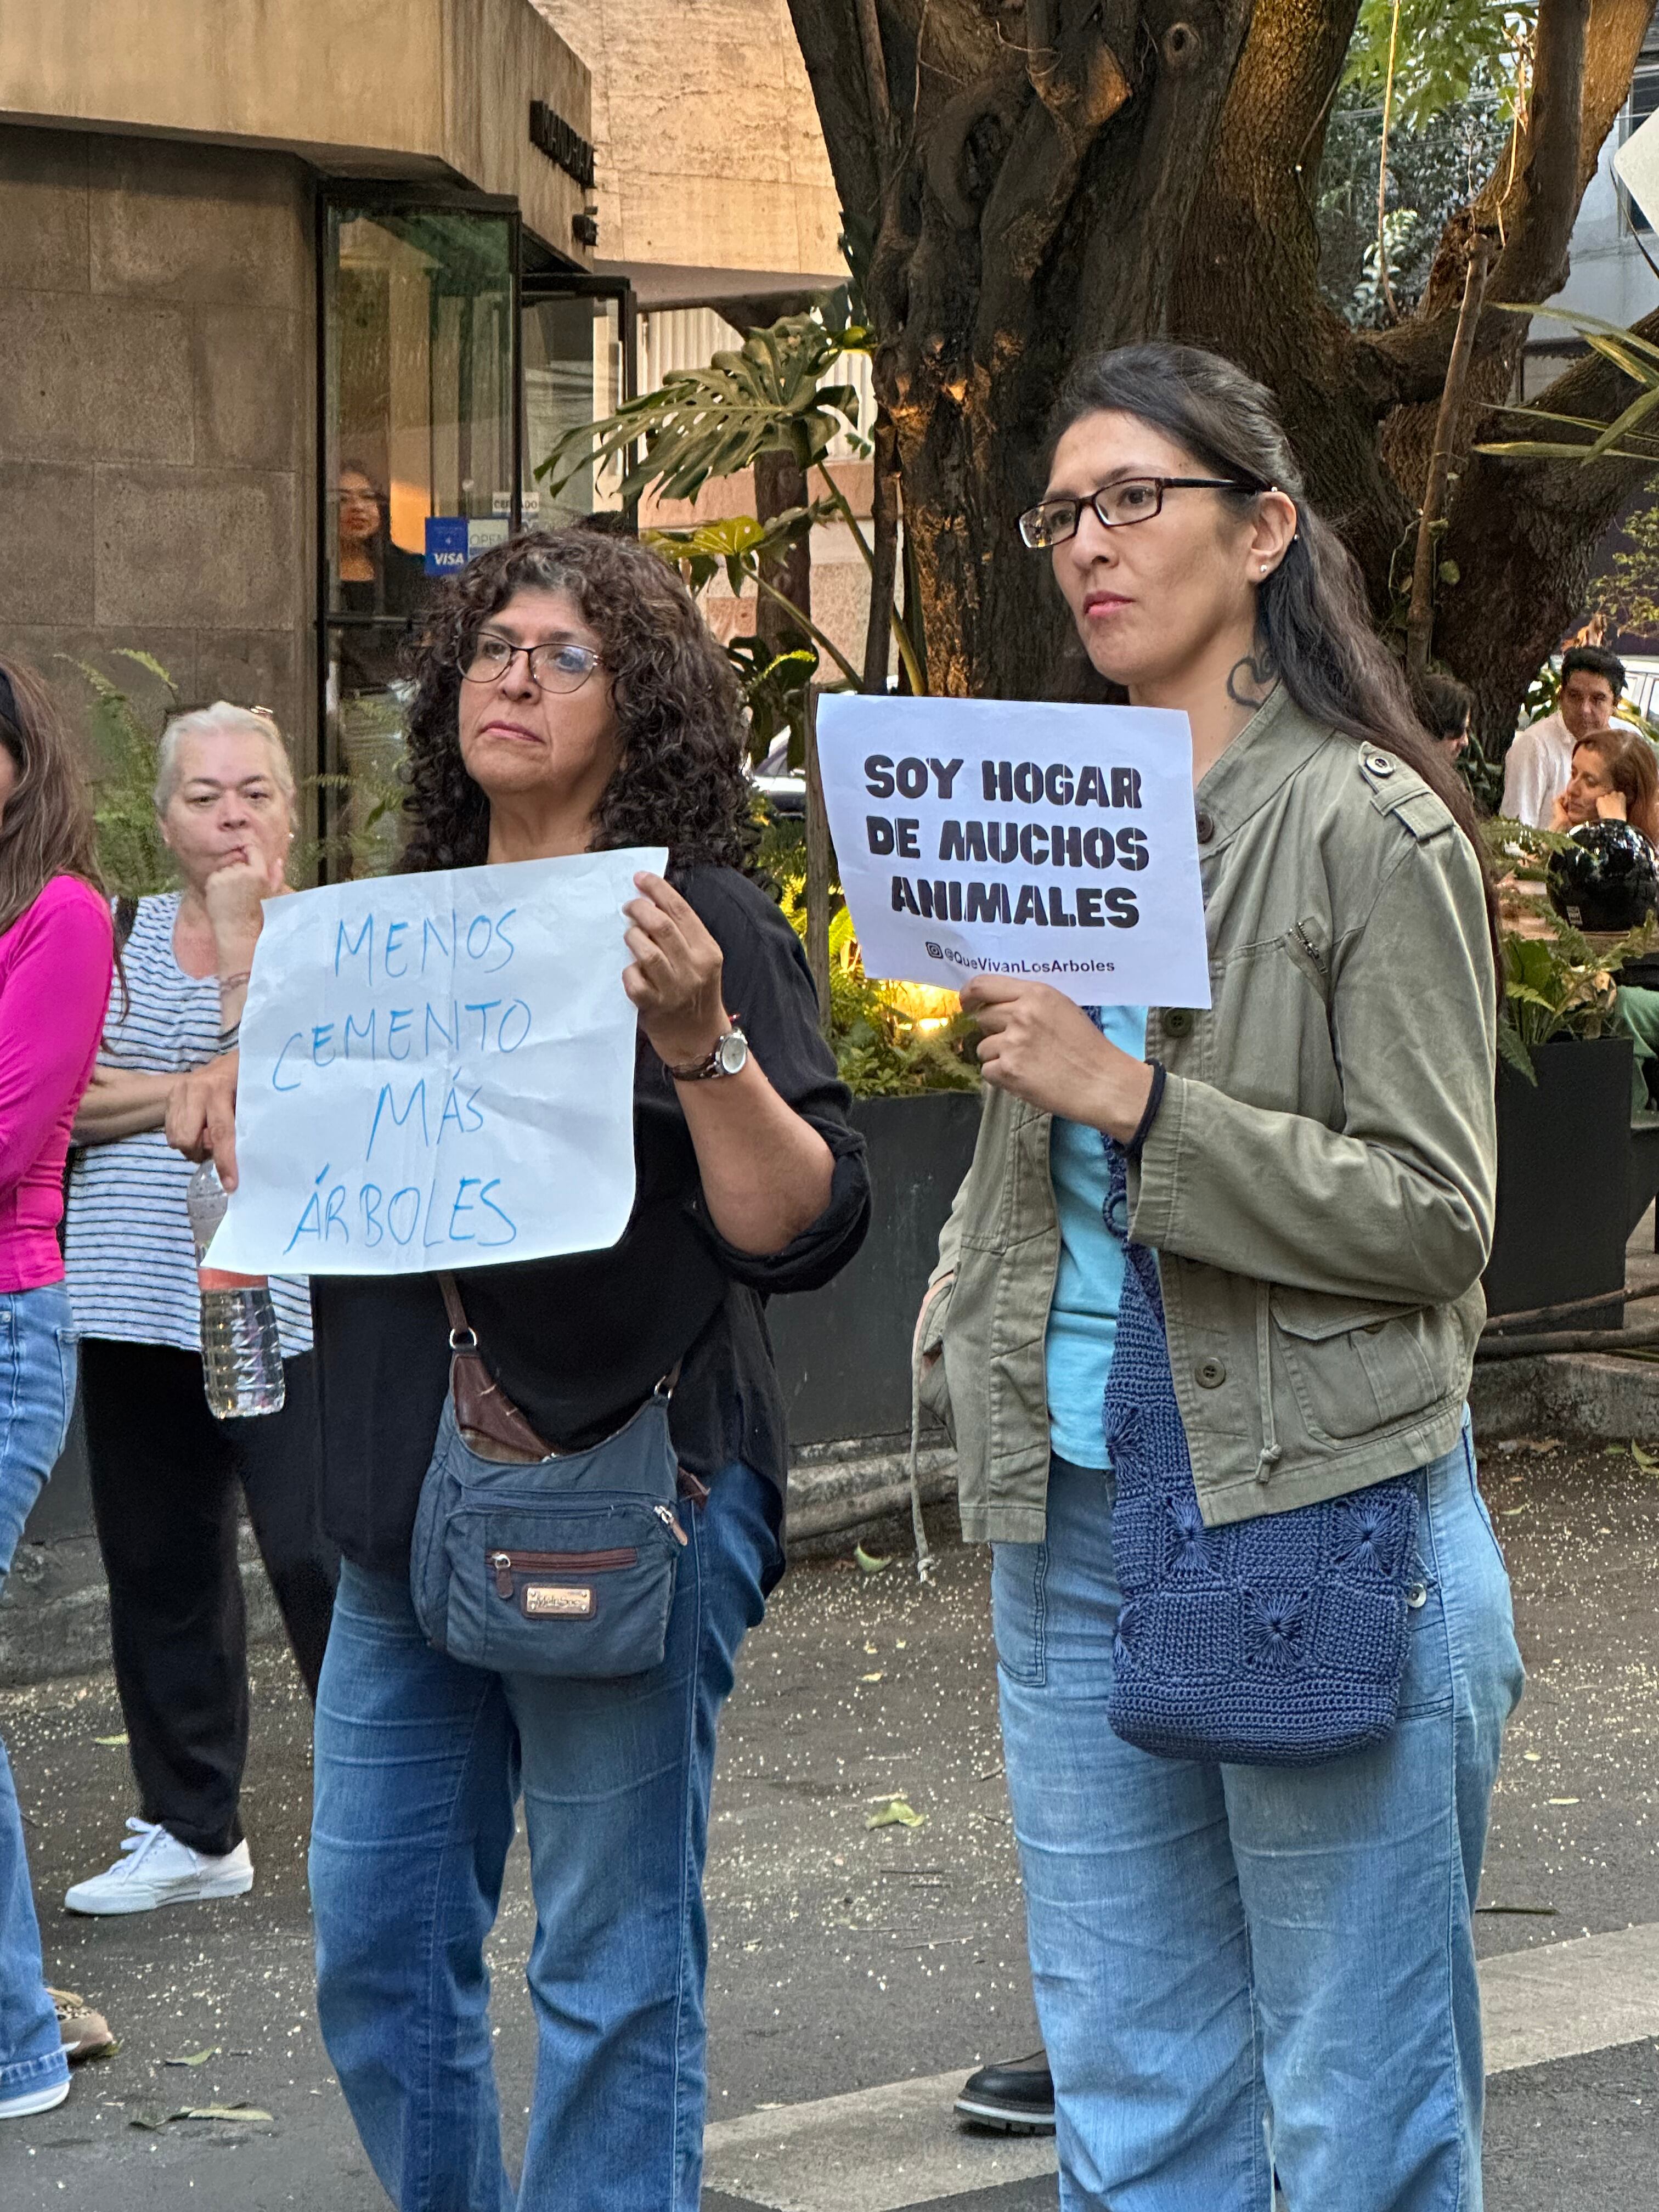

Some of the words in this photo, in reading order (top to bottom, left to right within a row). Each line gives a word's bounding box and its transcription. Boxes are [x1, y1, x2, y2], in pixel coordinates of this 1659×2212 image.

[434, 552, 464, 566] VISA
[865, 755, 964, 799] SOY
[982, 761, 1142, 809] HOGAR
[866, 816, 921, 859] DE
[939, 821, 1149, 871] MUCHOS
[892, 877, 1139, 928] ANIMALES
[335, 910, 516, 986] MENOS
[945, 948, 1115, 973] @QueVivanLosArboles
[273, 1000, 531, 1090] CEMENTO
[366, 1067, 483, 1161] MÁS
[283, 1164, 516, 1254] ÁRBOLES
